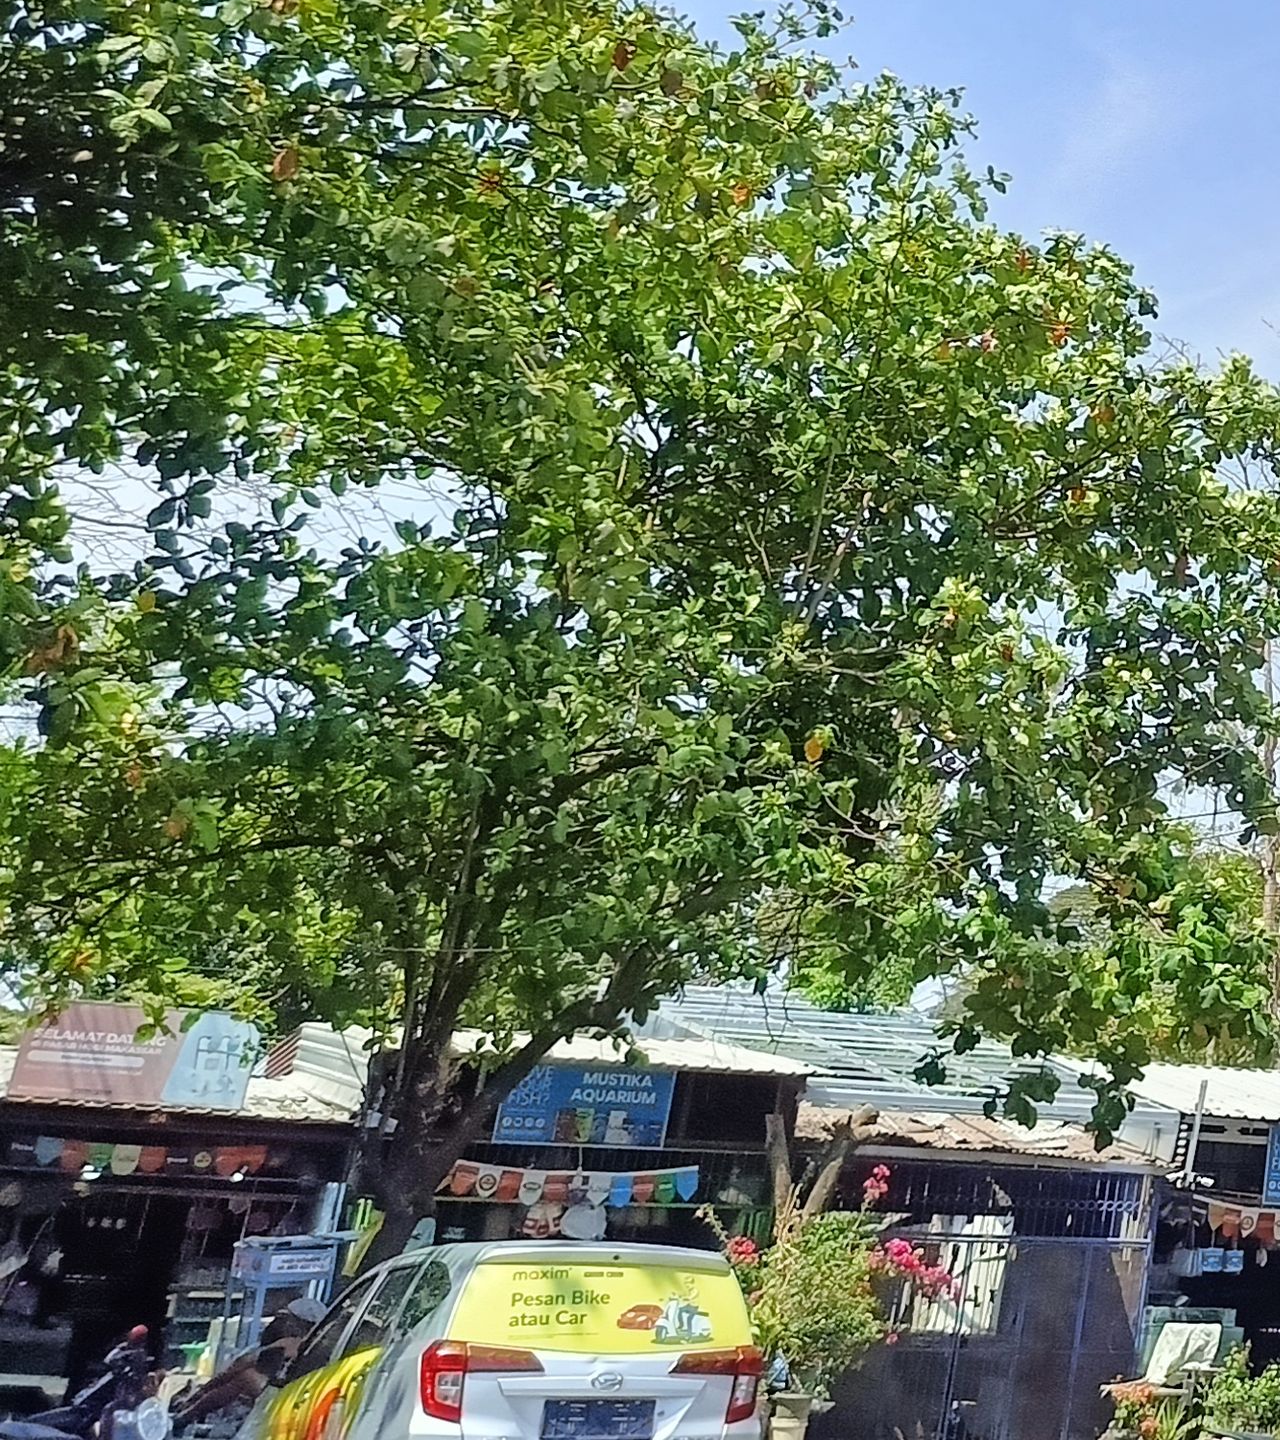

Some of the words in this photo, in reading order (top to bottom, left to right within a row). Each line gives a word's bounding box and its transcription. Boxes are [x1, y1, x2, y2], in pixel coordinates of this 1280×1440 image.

[106, 1031, 168, 1048] DATNG
[582, 1072, 653, 1088] MUSTIKA
[570, 1088, 657, 1105] AQUARIUM
[512, 1267, 569, 1281] maxim
[511, 1291, 566, 1307] Pesan
[571, 1290, 611, 1305] Bike
[508, 1312, 550, 1327] atau
[555, 1310, 588, 1325] Car
